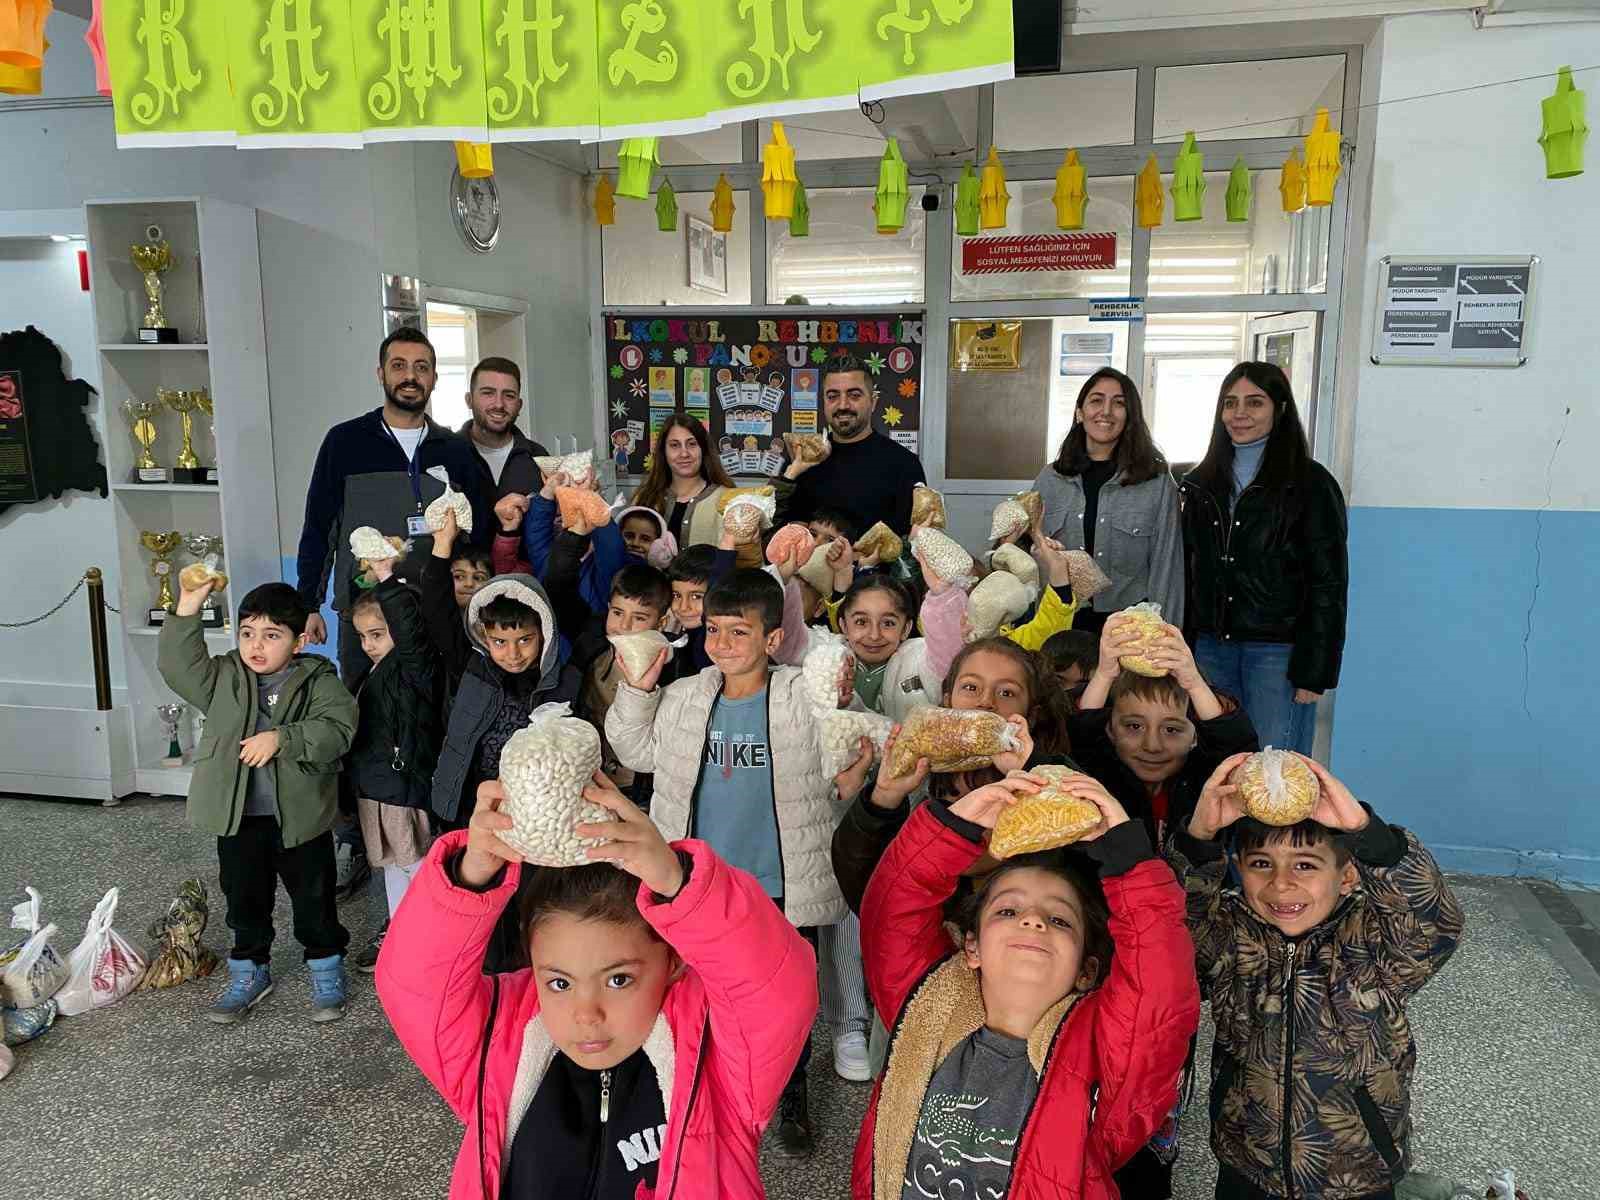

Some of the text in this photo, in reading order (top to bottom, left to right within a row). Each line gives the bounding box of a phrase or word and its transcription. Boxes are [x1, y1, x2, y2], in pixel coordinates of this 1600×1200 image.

[988, 245, 1021, 254] LÜTFEN
[1072, 241, 1091, 252] İÇİN
[976, 257, 1008, 266] SOSYAL
[1060, 254, 1103, 263] KORUYUN
[695, 342, 809, 367] PANOU
[703, 741, 767, 769] NIKE
